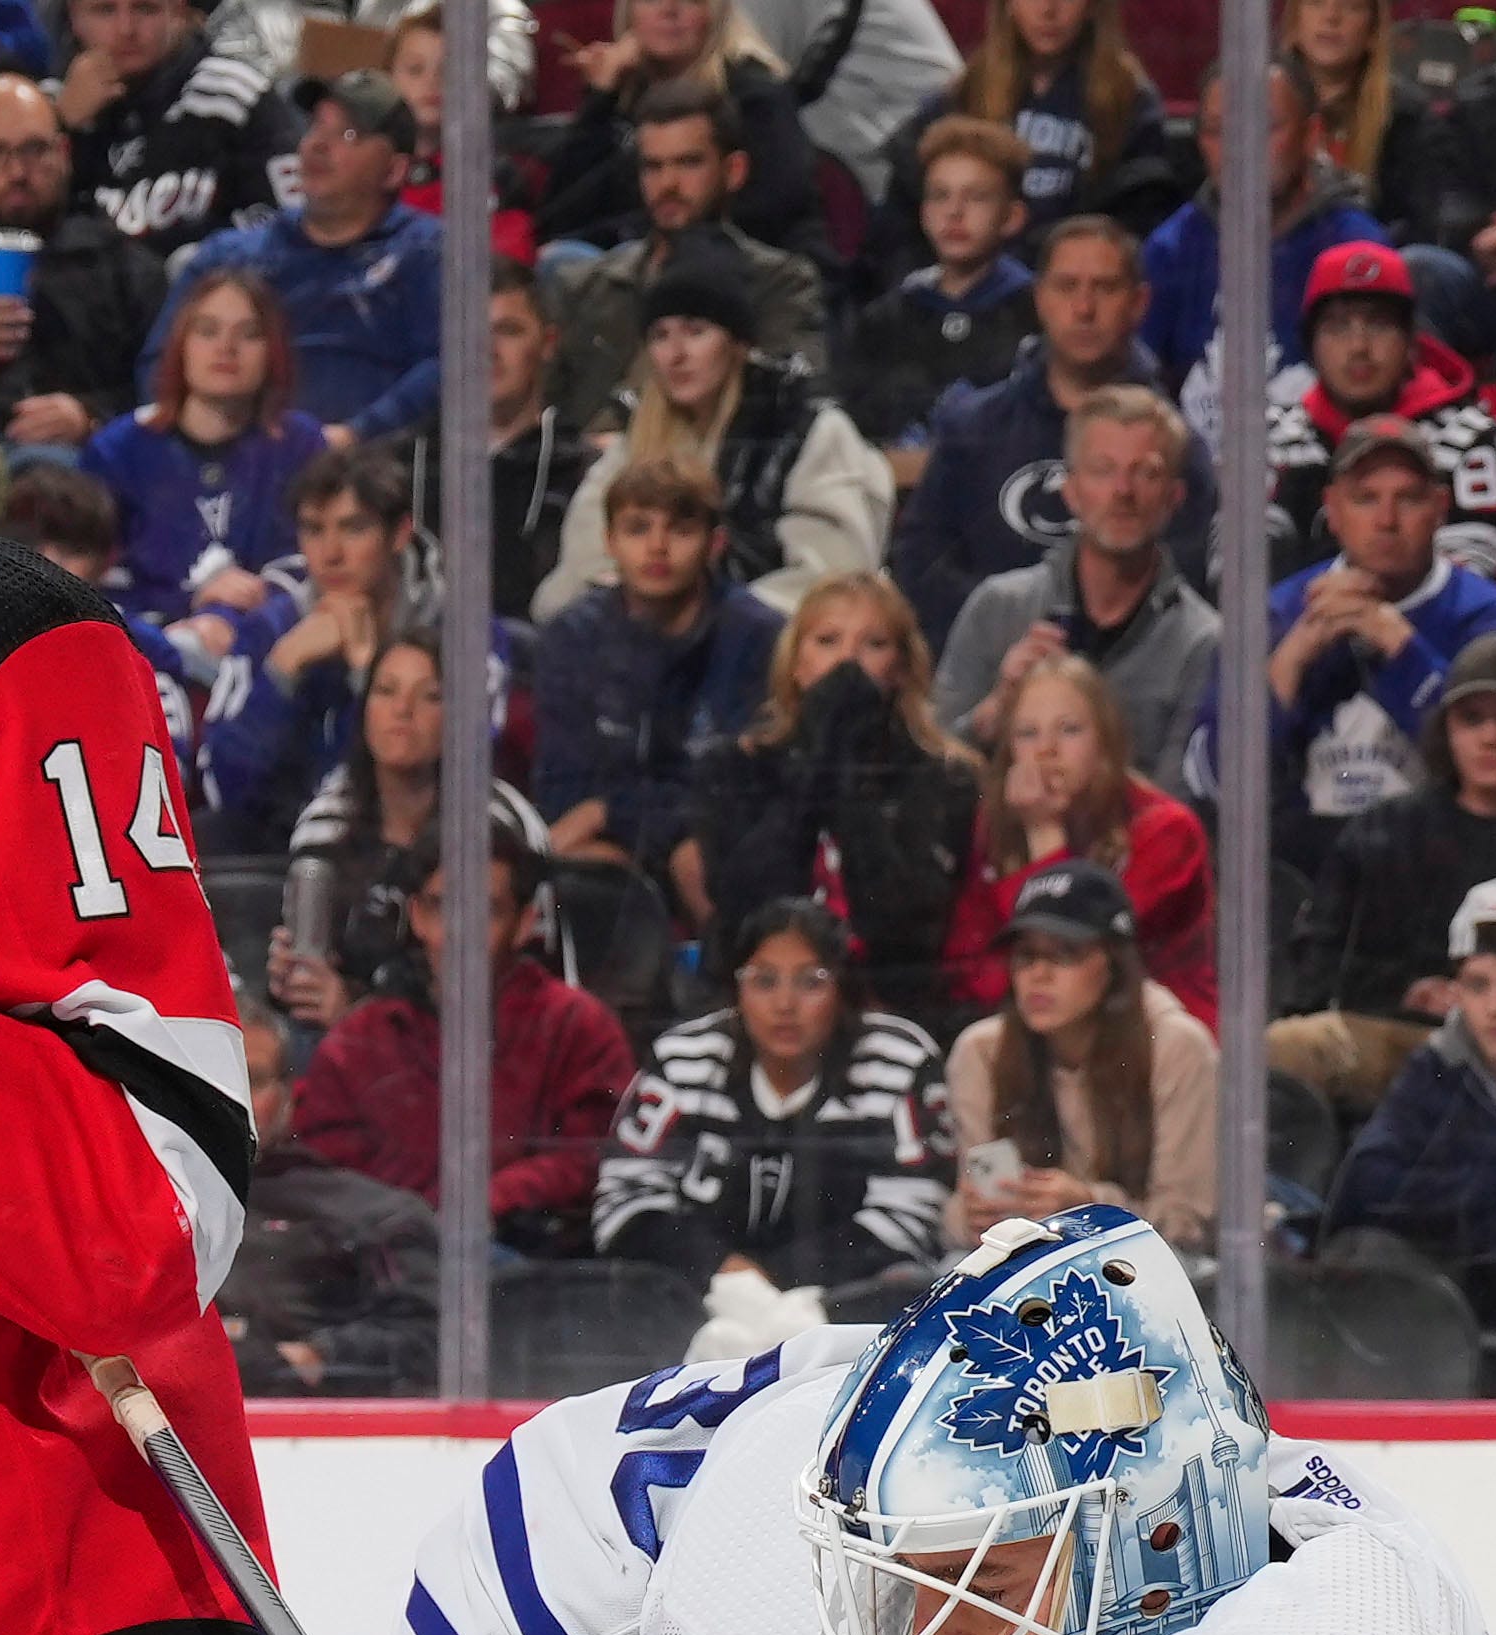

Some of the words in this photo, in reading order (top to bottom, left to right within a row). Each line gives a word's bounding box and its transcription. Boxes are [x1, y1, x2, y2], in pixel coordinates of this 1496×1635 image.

[43, 739, 210, 921] 14
[617, 1072, 681, 1153] 3
[681, 1130, 728, 1203] C
[1006, 1326, 1108, 1433] TORONTO
[1305, 1455, 1362, 1510] adidas
